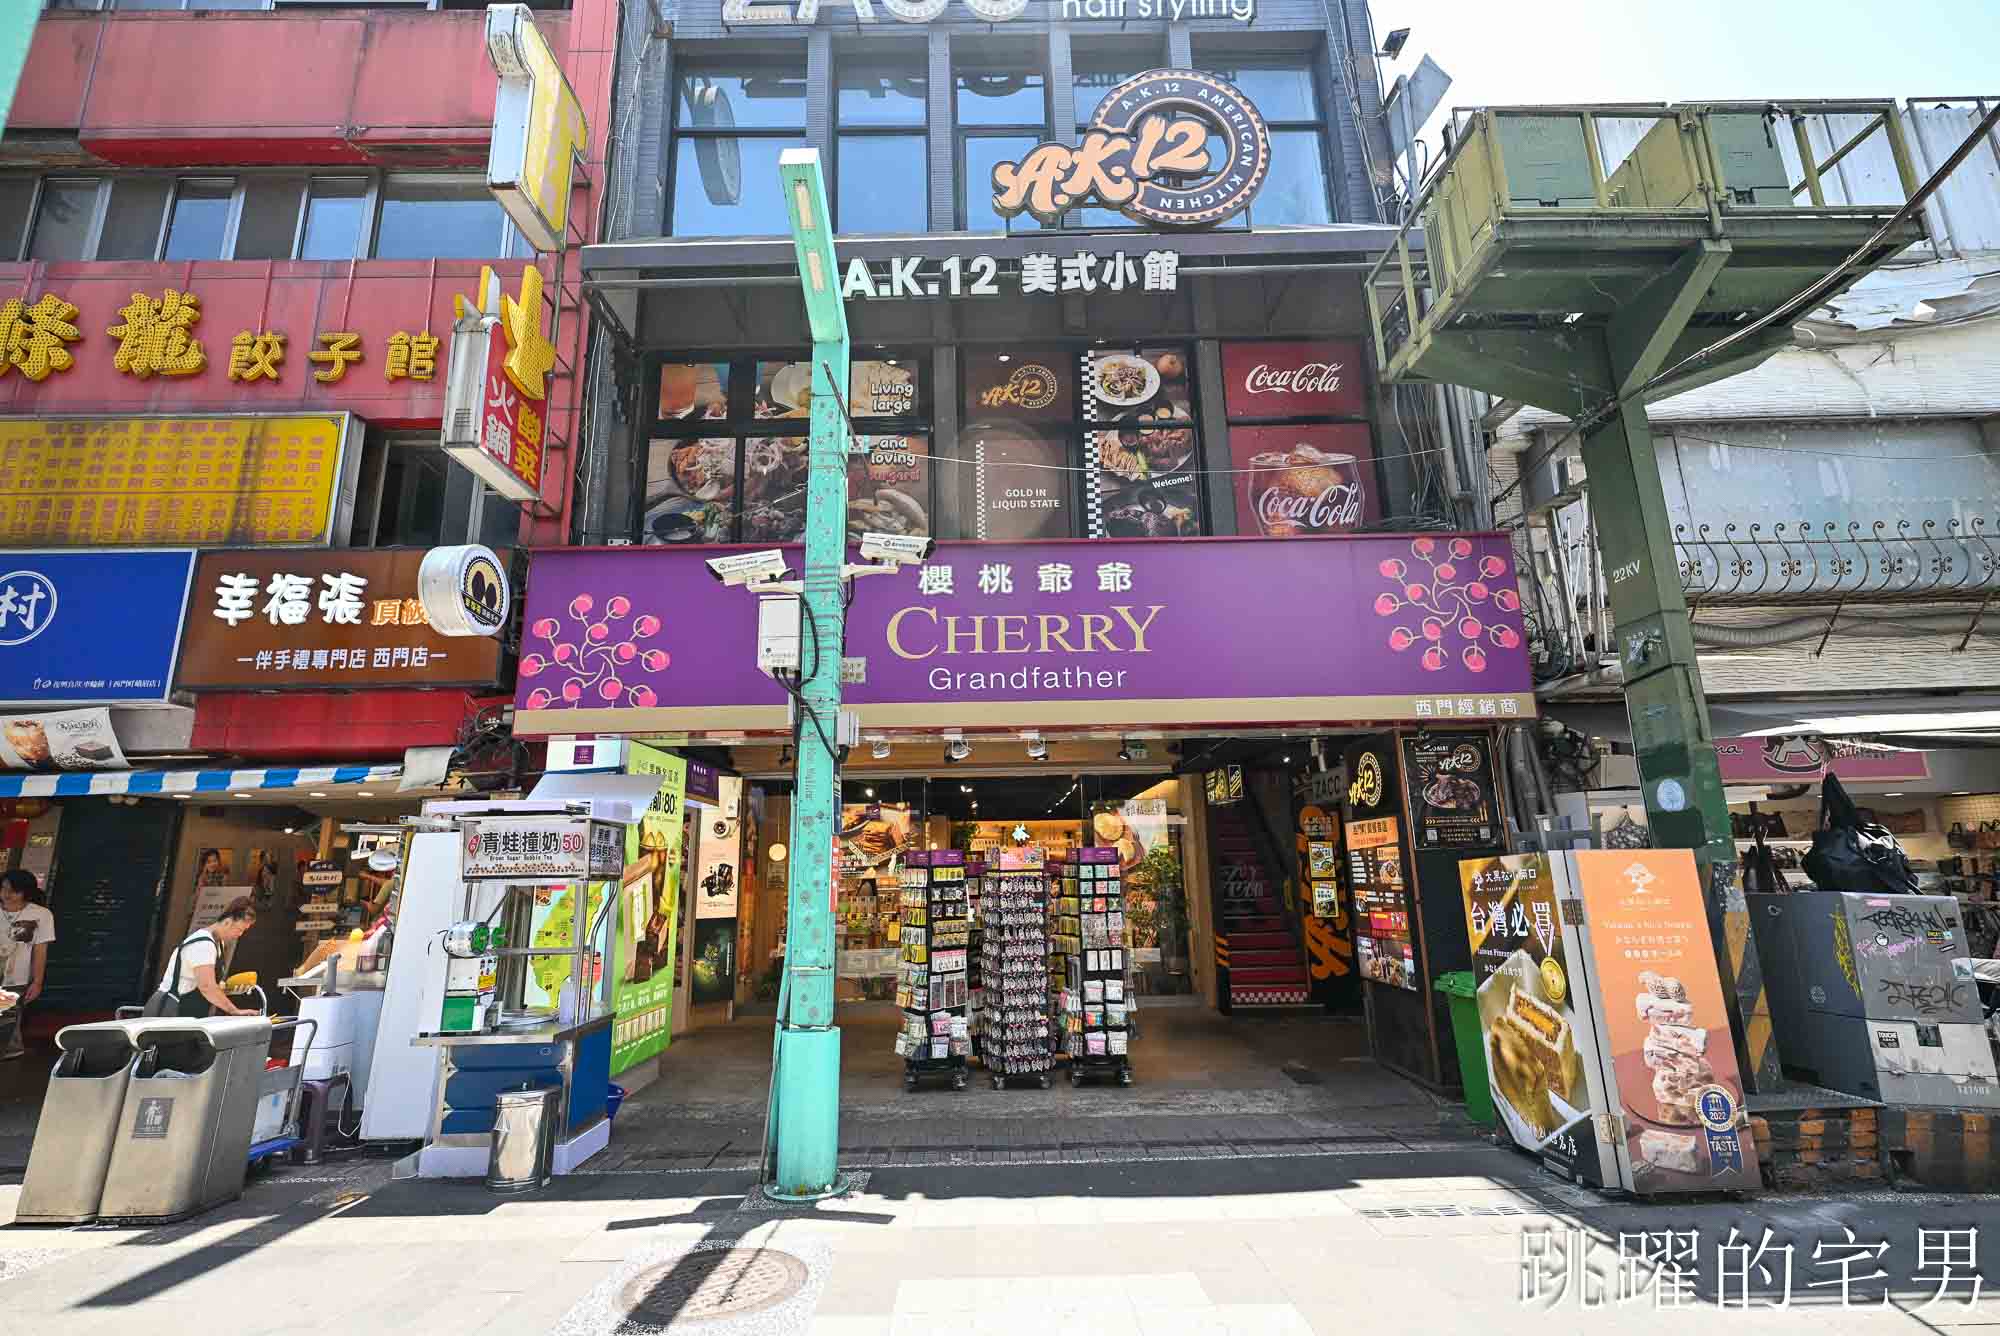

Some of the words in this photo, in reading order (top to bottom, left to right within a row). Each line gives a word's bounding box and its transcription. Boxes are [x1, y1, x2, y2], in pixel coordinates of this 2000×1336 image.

[1197, 87, 1254, 168] AMERICAN
[1158, 173, 1245, 210] KITCHEN
[842, 254, 999, 298] A.K.12
[1020, 250, 1180, 295] 美式小館
[1246, 362, 1344, 394] Coca-Cola
[871, 383, 914, 397] Living
[873, 400, 911, 413] large
[880, 437, 908, 448] and
[871, 452, 916, 466] loving
[1152, 474, 1193, 489] Welcome!
[1005, 489, 1033, 498] GOLD
[1035, 489, 1047, 498] IN
[992, 499, 1026, 510] LIQUID
[1029, 499, 1061, 509] STATE
[918, 562, 1133, 595] 櫻桃爺爺
[1613, 560, 1640, 583] 22KV
[212, 572, 369, 627] 幸福張
[886, 605, 1168, 660] CHERRY
[928, 666, 1128, 690] Grandfather
[1415, 698, 1518, 716] 西門經銷商
[482, 831, 559, 854] 青蛙撞奶
[562, 833, 584, 853] 50
[1710, 1111, 1727, 1120] 2022
[1709, 1140, 1739, 1152] TASTE
